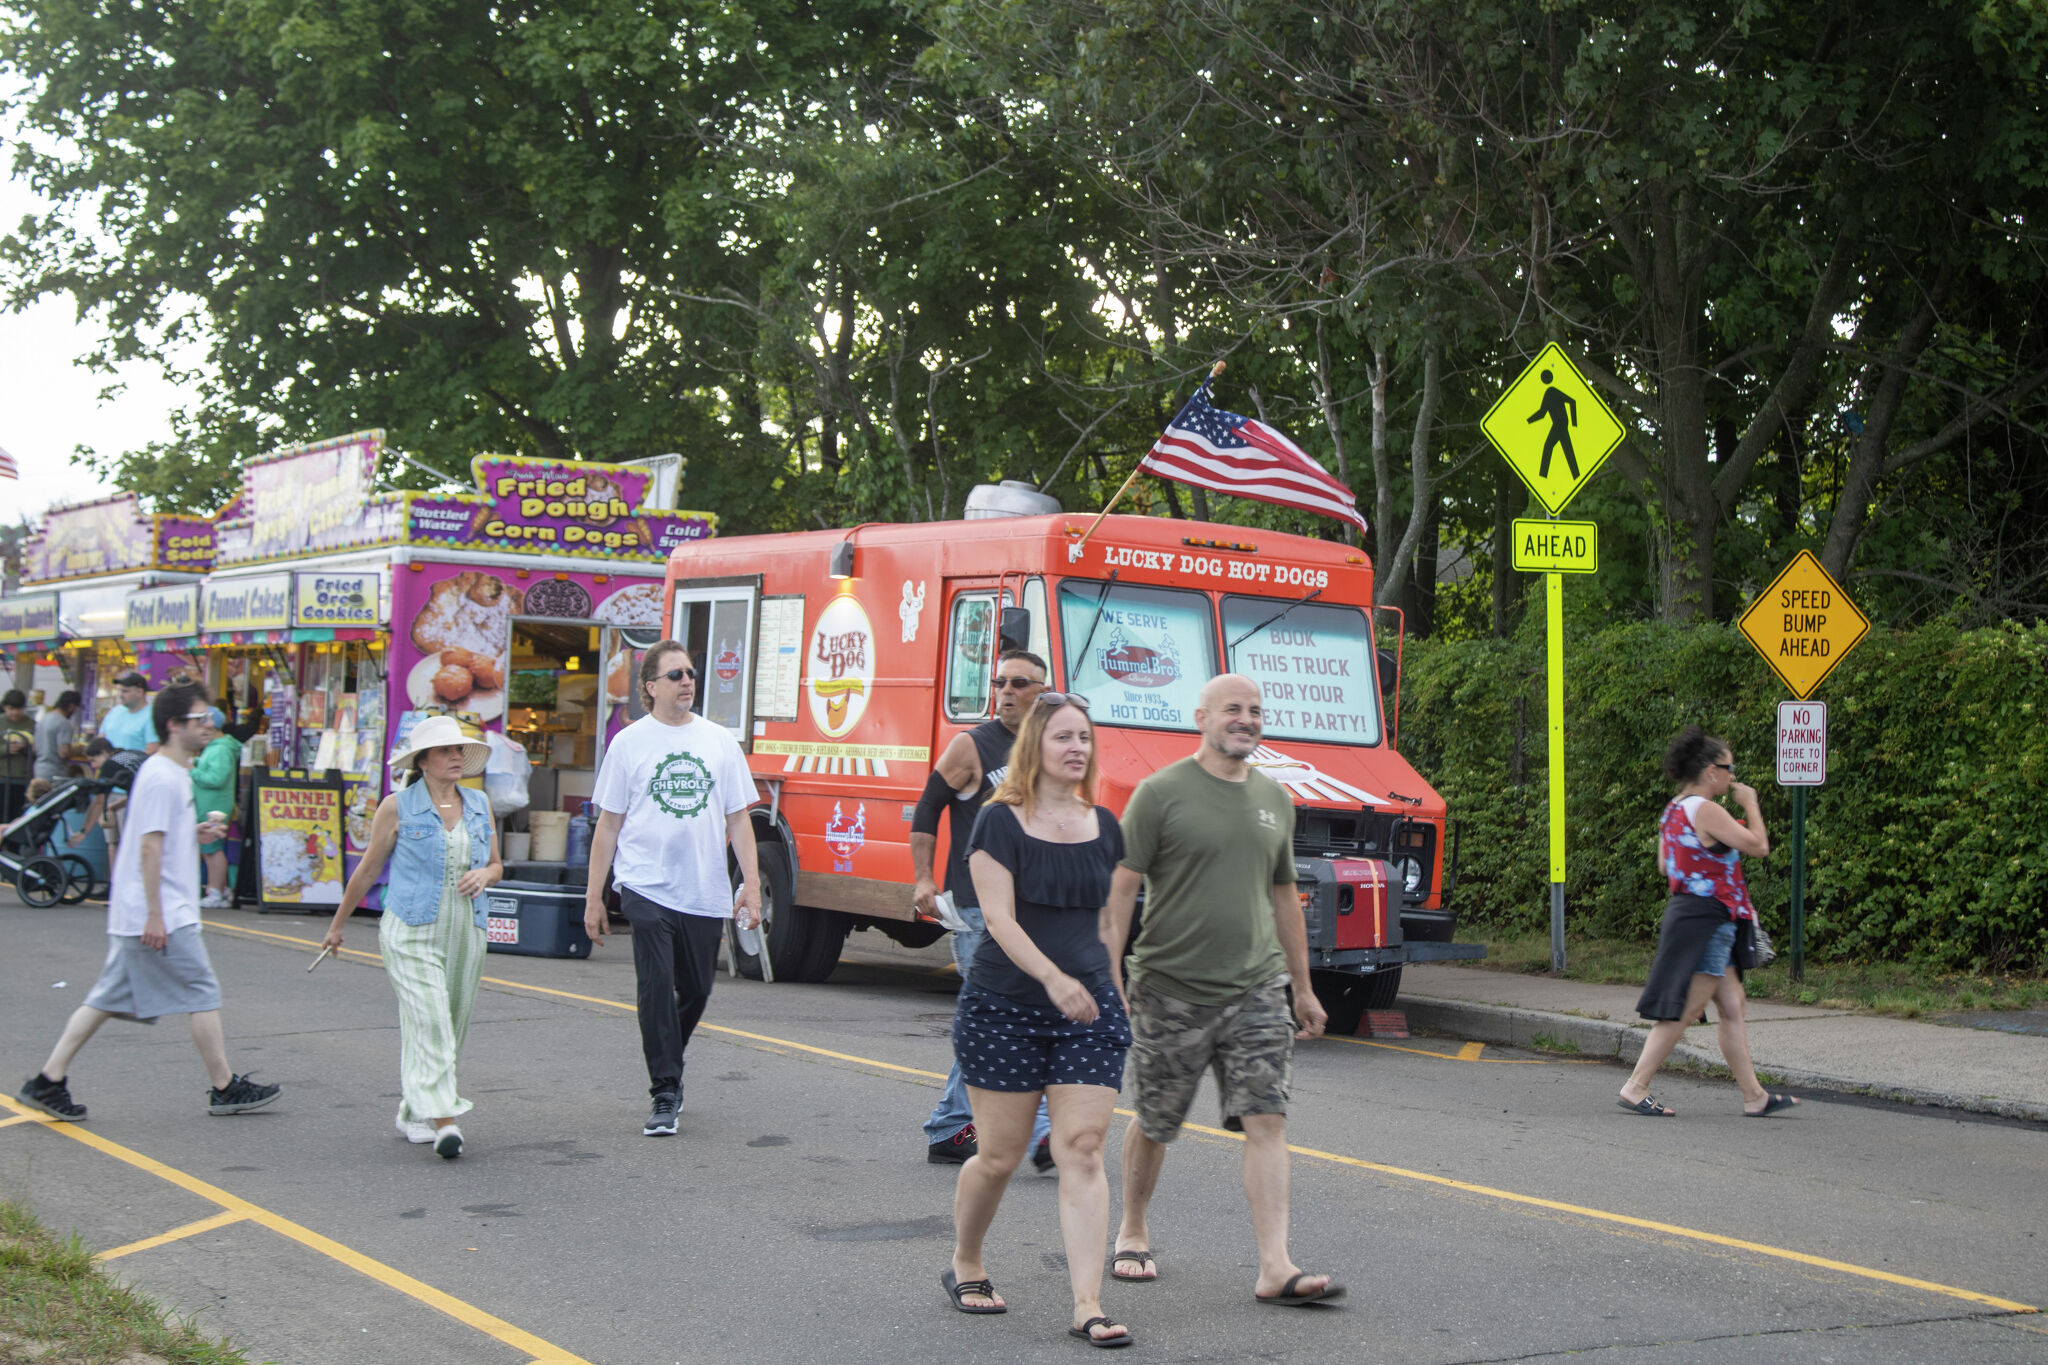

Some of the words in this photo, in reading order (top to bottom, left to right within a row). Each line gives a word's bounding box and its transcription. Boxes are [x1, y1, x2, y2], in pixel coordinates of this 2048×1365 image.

[496, 476, 587, 498] Fried
[414, 506, 470, 521] Bottled
[520, 496, 630, 521] Dough
[419, 519, 463, 532] Water
[484, 520, 557, 541] Corn
[562, 525, 640, 549] Dogs
[665, 524, 702, 538] Cold
[167, 534, 212, 549] Cold
[1524, 533, 1587, 559] AHEAD
[165, 548, 216, 562] Soda
[1104, 546, 1175, 571] LUCKY
[1179, 555, 1223, 577] DOG
[1227, 561, 1270, 582] HOT
[1274, 566, 1329, 588] DOGS
[315, 578, 363, 592] Fried
[208, 588, 249, 622] Funnel
[250, 586, 285, 619] Cakes
[1781, 589, 1831, 609] SPEED
[128, 597, 155, 629] Fried
[156, 592, 190, 631] Dough
[303, 605, 374, 620] Cookies
[1101, 608, 1124, 625] WE
[1127, 612, 1168, 630] SERVE
[1783, 613, 1827, 633] BUMP
[817, 631, 867, 664] LUCKY
[1269, 628, 1317, 648] BOOK
[1779, 637, 1831, 657] AHEAD
[831, 650, 865, 679] DOG
[1096, 647, 1151, 674] Hummel
[1247, 653, 1288, 673] THIS
[1292, 656, 1351, 677] TRUCK
[1123, 690, 1143, 704] Since
[1262, 681, 1295, 701] FOR
[1296, 683, 1345, 704] YOUR
[1111, 704, 1138, 719] HOT
[1143, 706, 1182, 723] DOGS!
[1261, 708, 1295, 728] EXT
[1301, 711, 1367, 733] PARTY!
[1793, 709, 1811, 726] NO
[1781, 728, 1822, 744] PARKING
[1782, 748, 1805, 759] HERE
[1809, 748, 1820, 759] TO
[666, 760, 683, 770] SINCE
[1783, 762, 1819, 773] CORNER
[652, 780, 711, 792] CHEVROLET
[986, 765, 1009, 788] HAR
[263, 789, 336, 807] FUNNEL
[270, 805, 329, 821] CAKES
[487, 918, 516, 930] COLD
[487, 931, 516, 942] SODA
